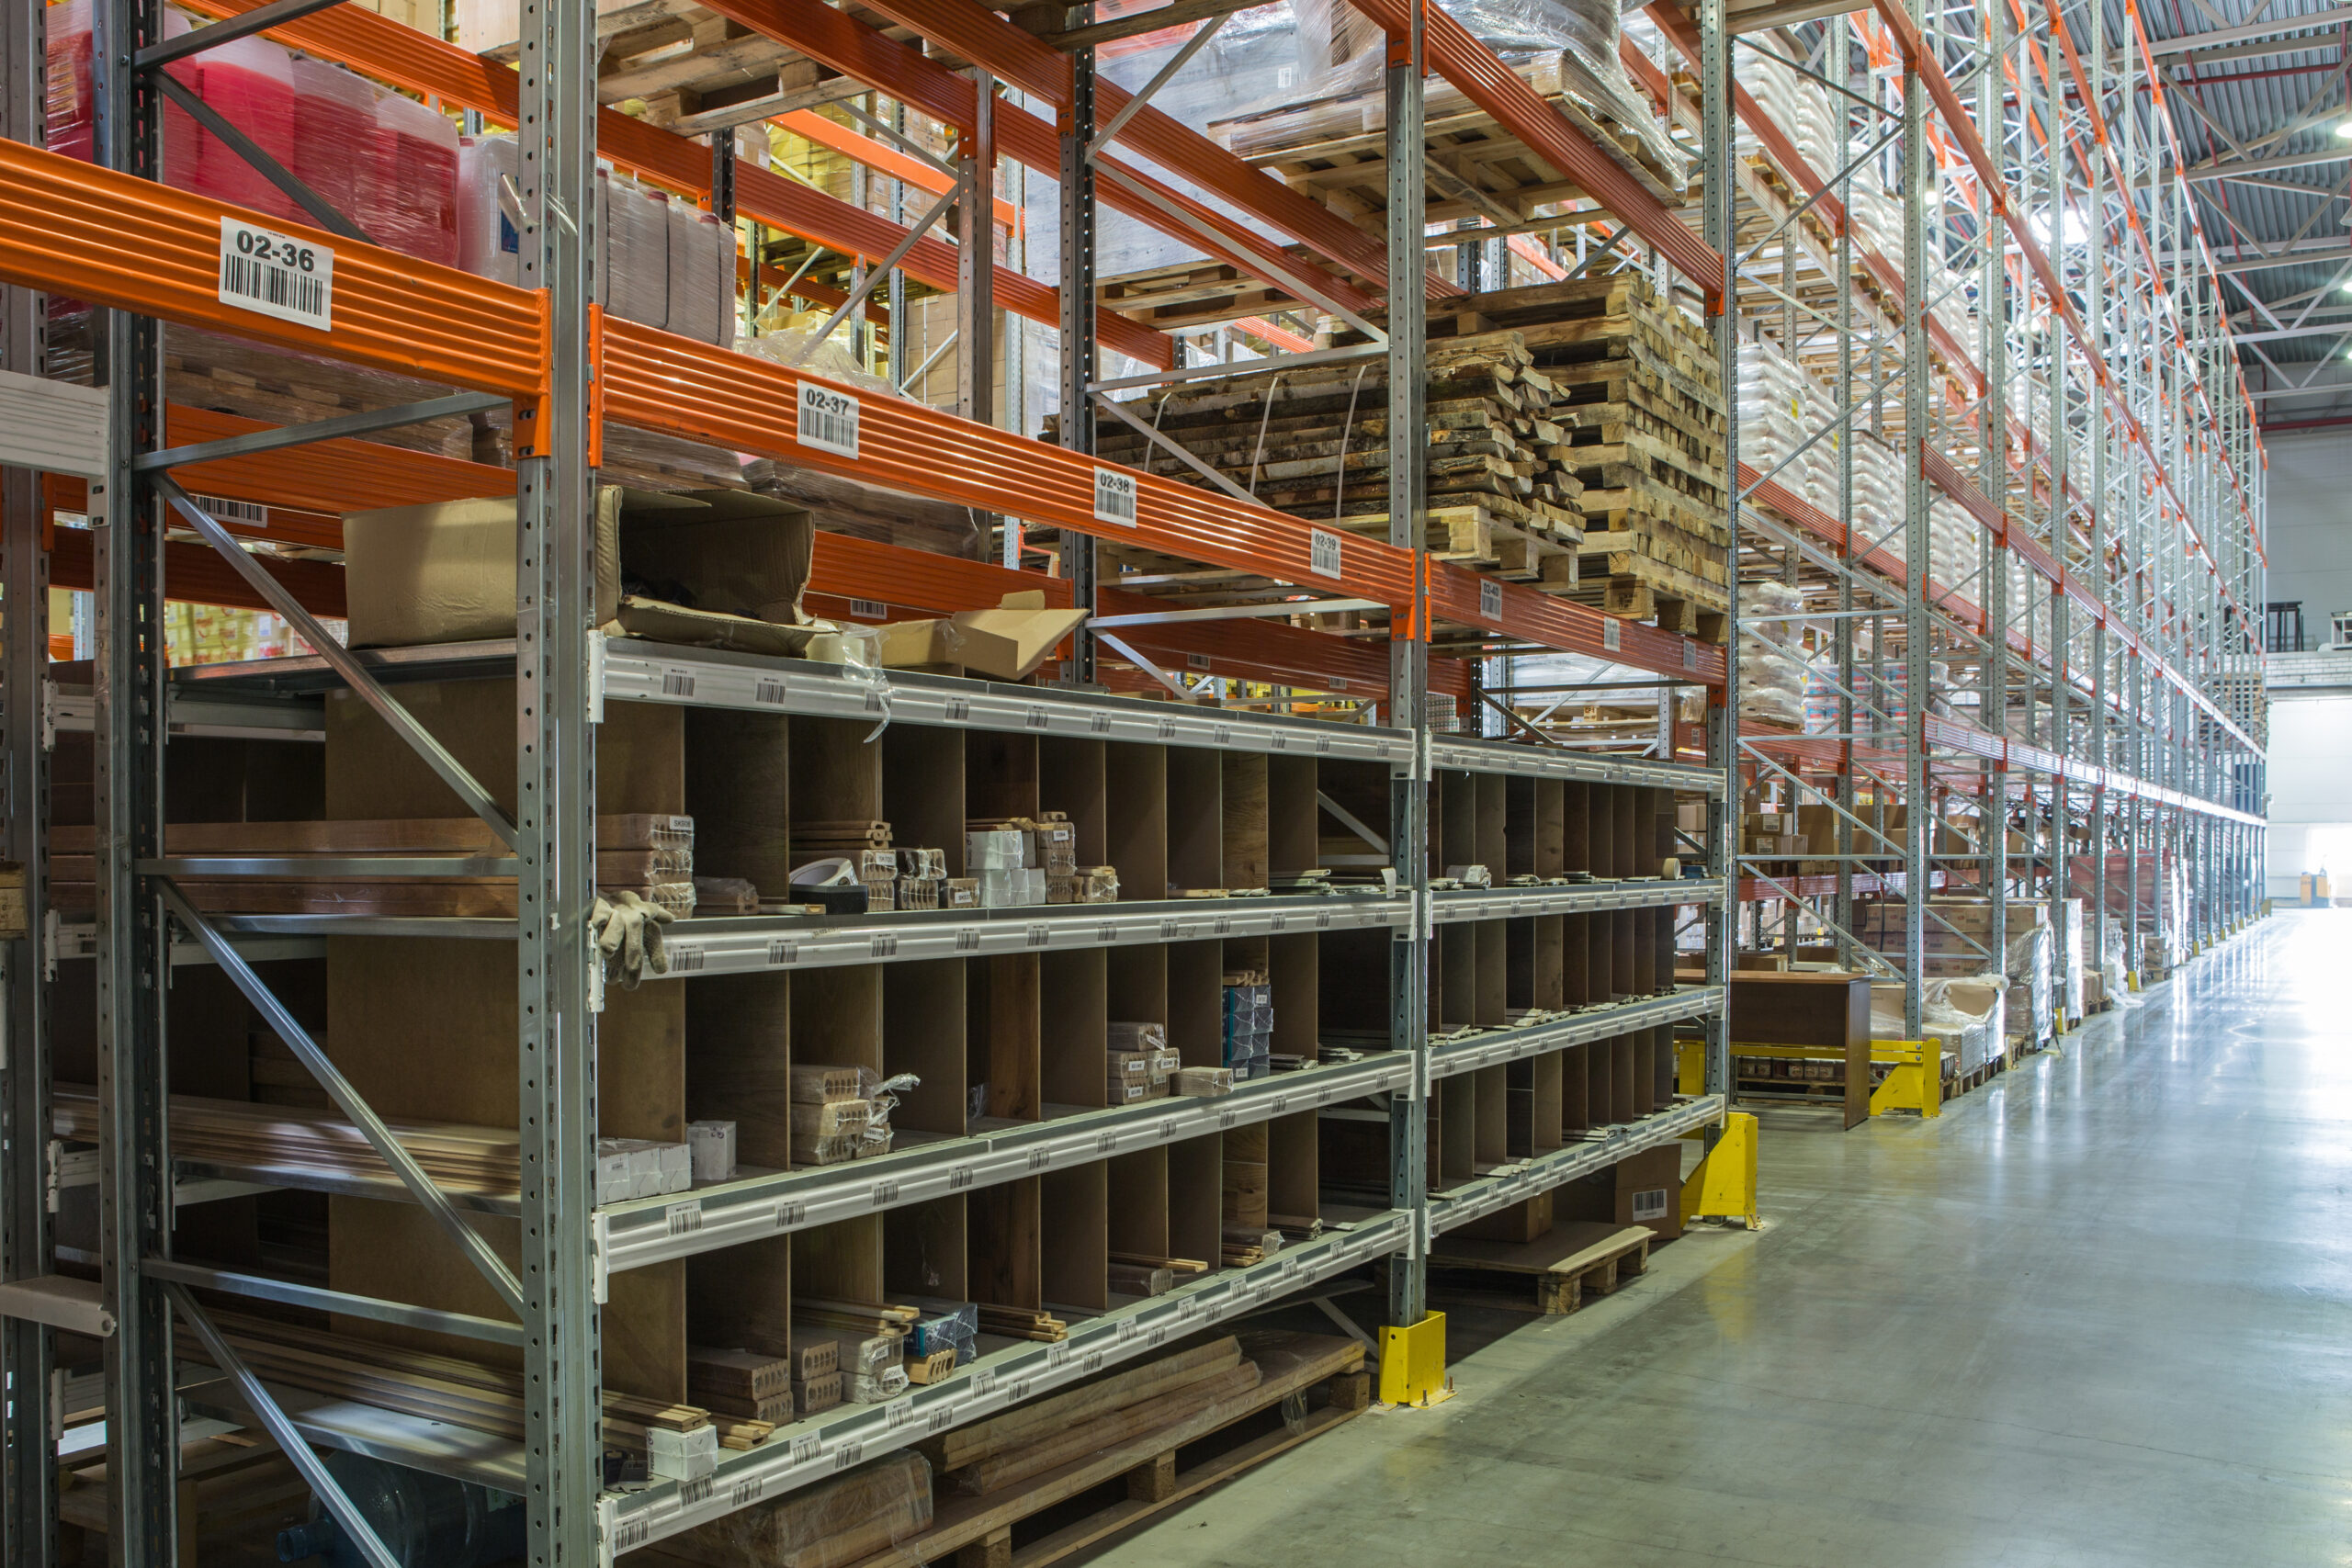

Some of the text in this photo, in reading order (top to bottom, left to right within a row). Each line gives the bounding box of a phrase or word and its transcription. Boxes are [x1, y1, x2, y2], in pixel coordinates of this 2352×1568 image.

[237, 230, 315, 273] 02-36
[806, 388, 850, 416] 02-37
[1100, 472, 1130, 493] 02-38
[1315, 533, 1337, 550] 02-39
